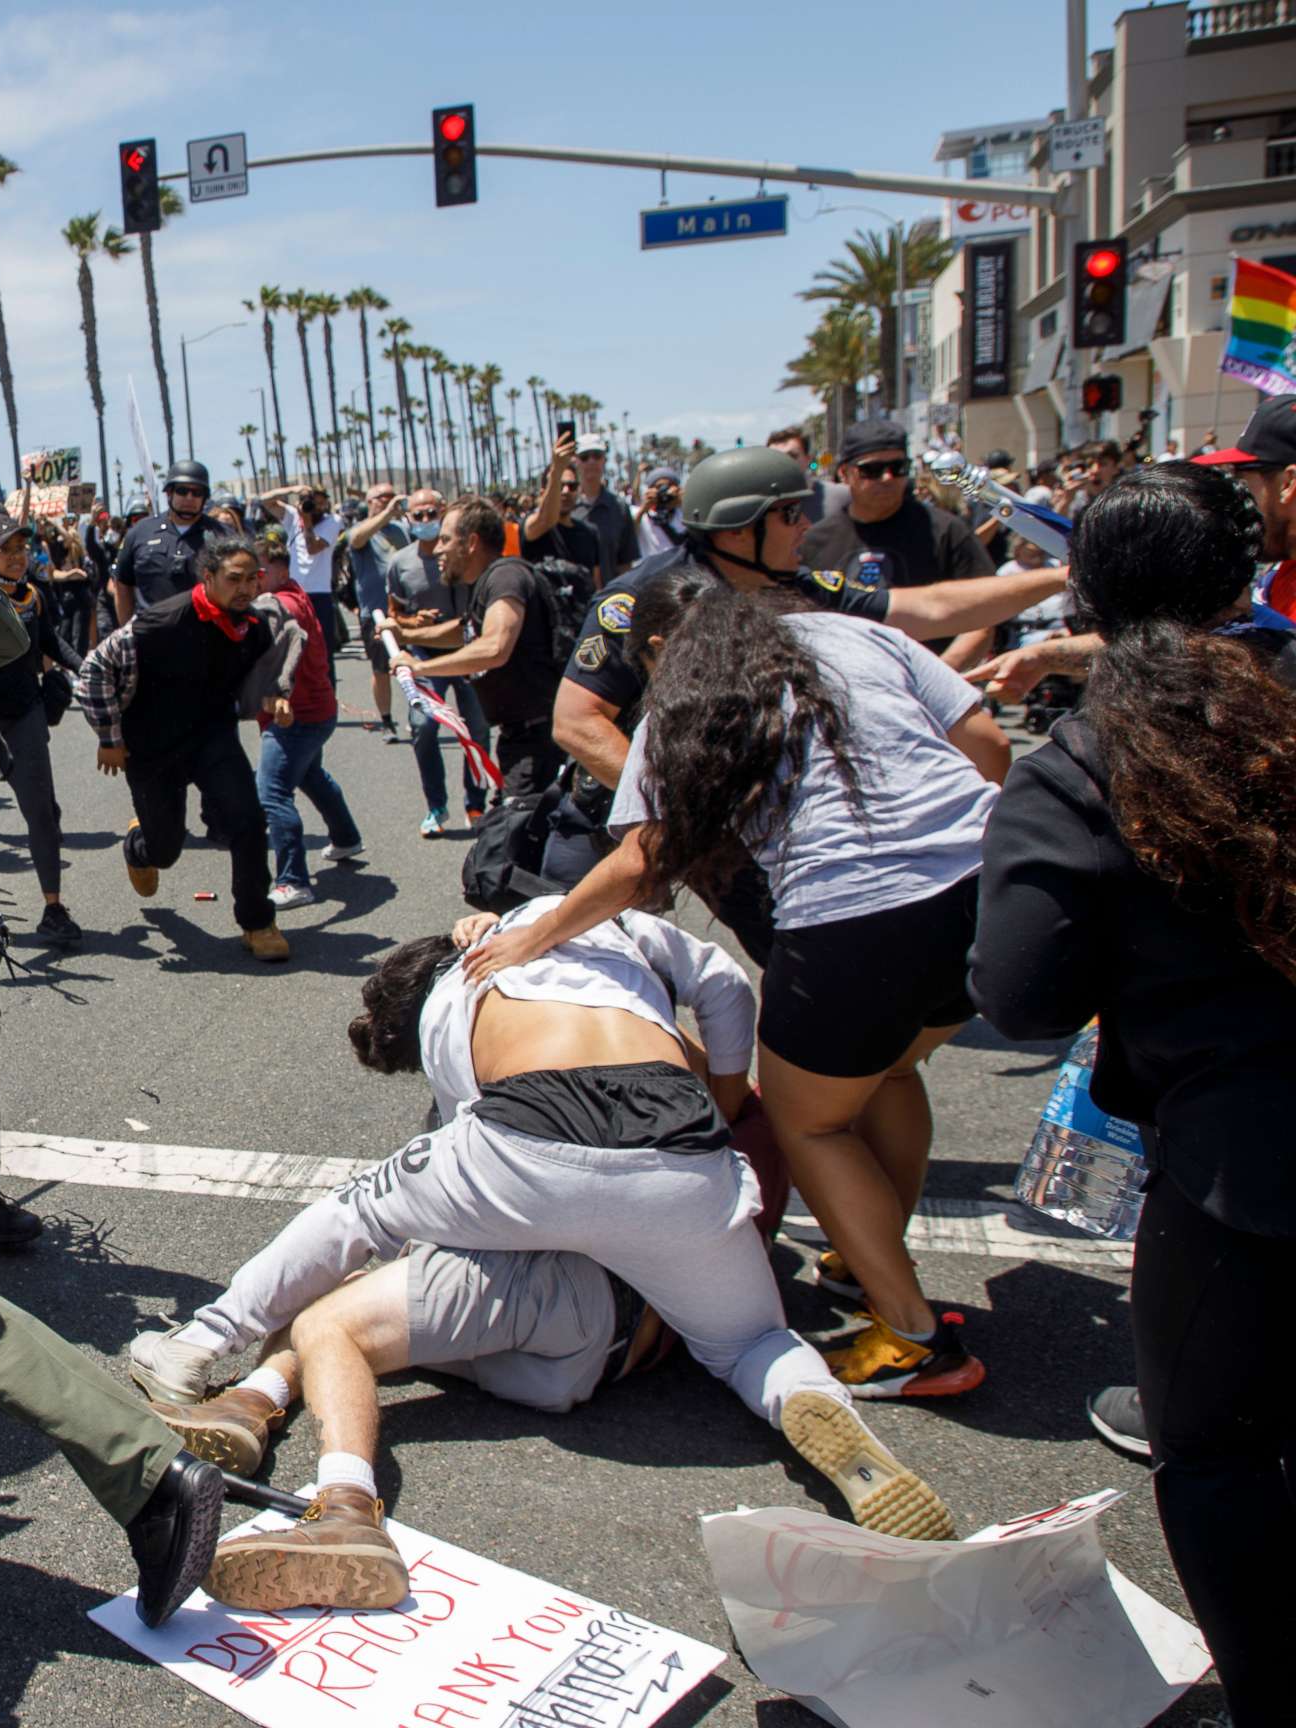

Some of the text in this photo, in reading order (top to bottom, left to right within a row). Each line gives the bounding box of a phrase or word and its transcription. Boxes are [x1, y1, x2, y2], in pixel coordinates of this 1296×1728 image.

[1055, 121, 1100, 137] TRUCK
[1054, 135, 1100, 151] ROUTE
[677, 211, 752, 235] Main
[30, 457, 79, 484] LOVE
[492, 1597, 595, 1652] YOU
